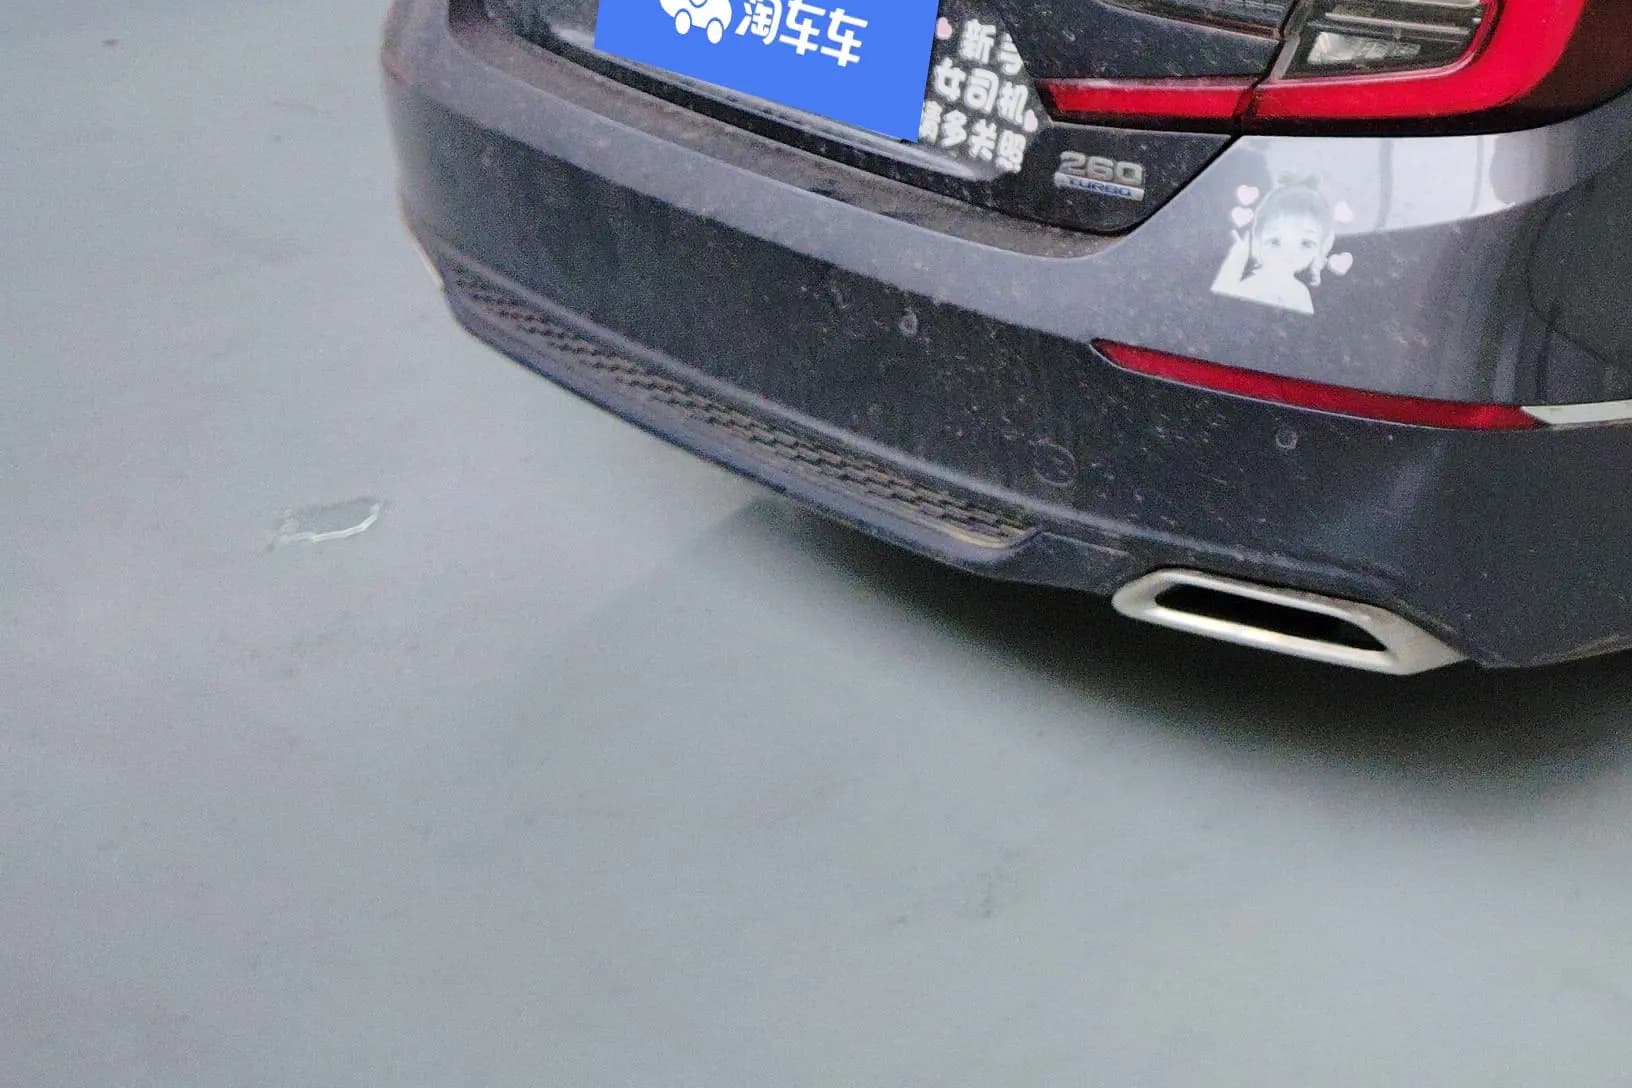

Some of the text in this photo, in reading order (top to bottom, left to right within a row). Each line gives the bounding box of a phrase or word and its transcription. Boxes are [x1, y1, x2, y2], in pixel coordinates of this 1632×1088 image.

[933, 57, 1029, 126] 女司机
[1059, 151, 1143, 185] 260
